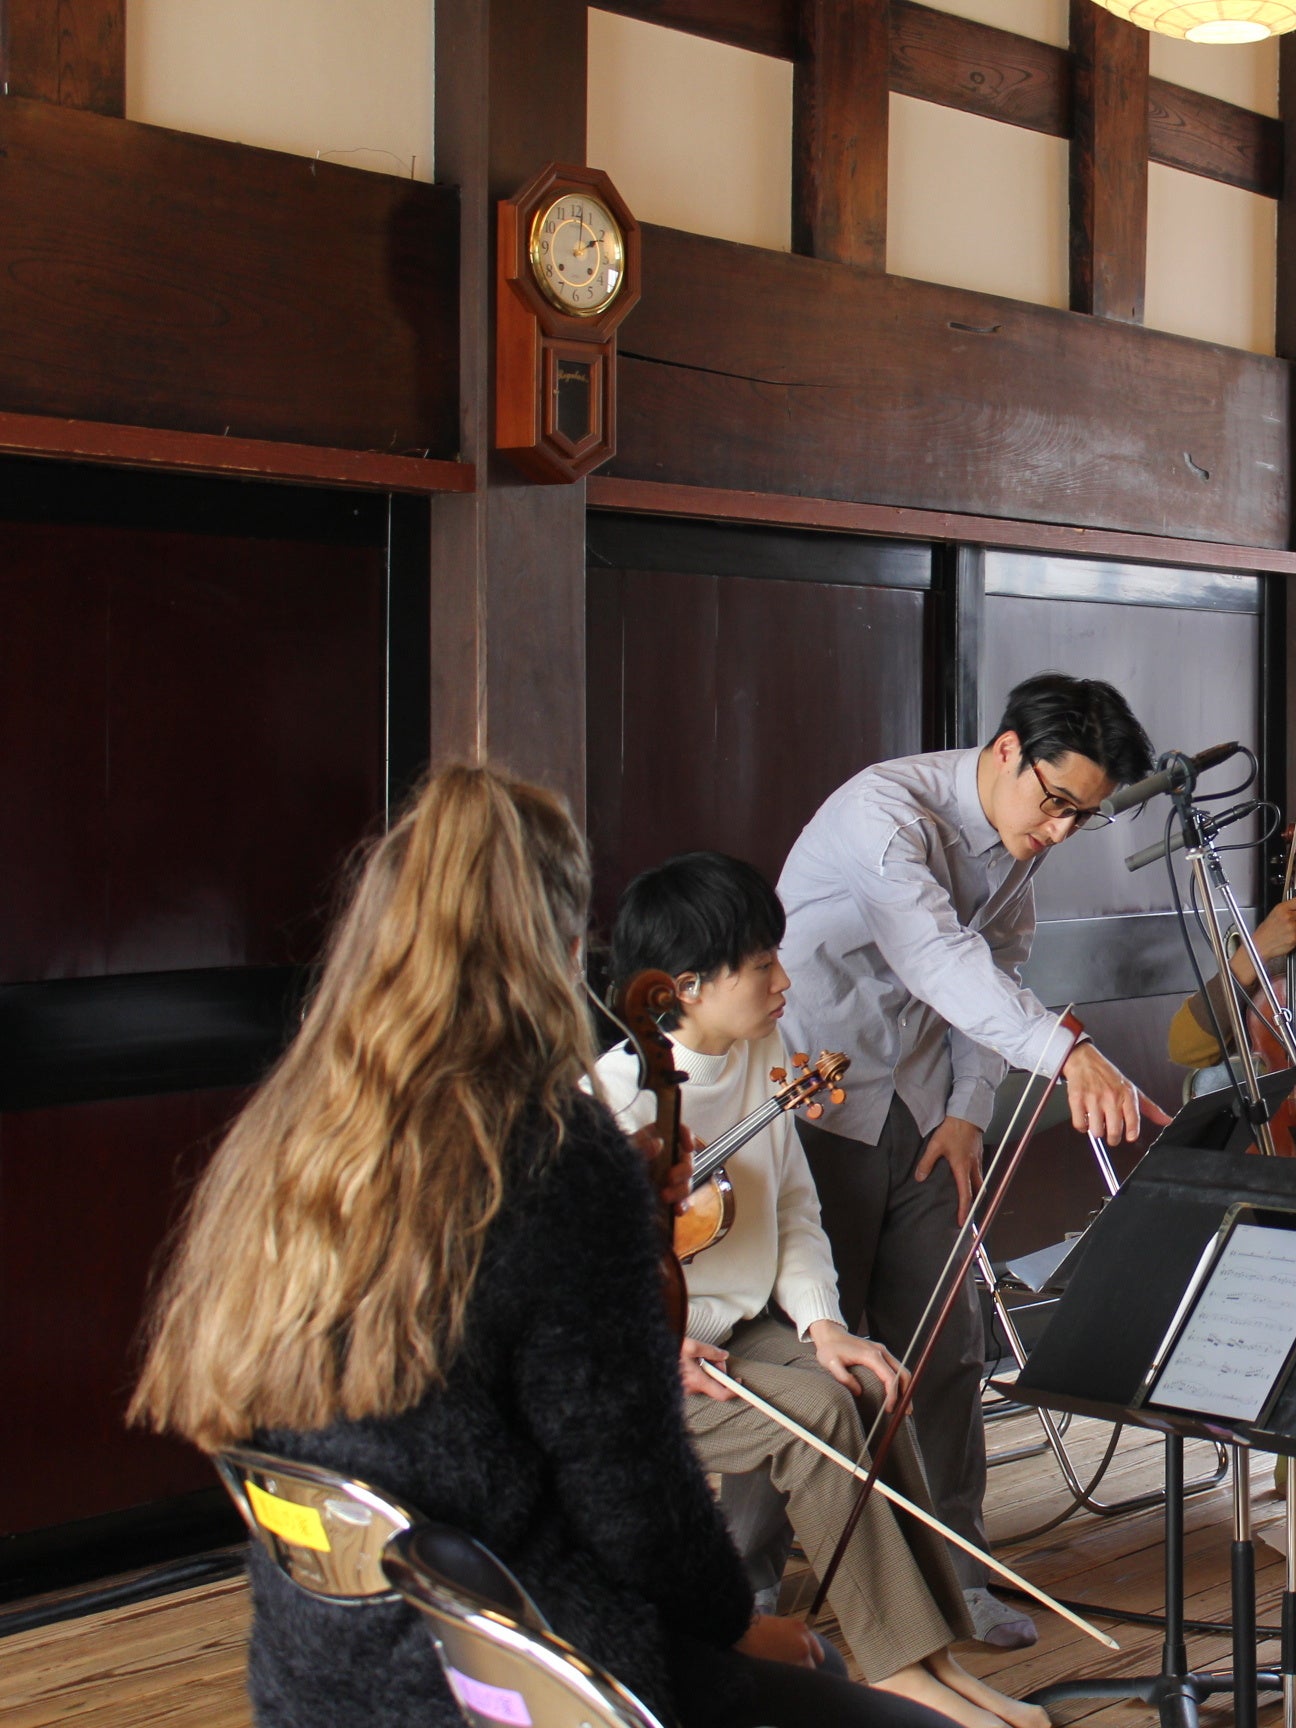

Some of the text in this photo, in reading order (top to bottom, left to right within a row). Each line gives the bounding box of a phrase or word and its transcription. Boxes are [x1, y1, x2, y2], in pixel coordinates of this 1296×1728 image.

[557, 206, 565, 221] 11
[571, 204, 582, 218] 12
[588, 212, 593, 225] 1
[545, 220, 556, 234] 10
[599, 229, 606, 242] 2
[542, 240, 549, 255] 9
[546, 264, 553, 277] 8
[596, 273, 604, 286] 4
[558, 281, 565, 294] 7
[587, 285, 593, 299] 5
[572, 289, 579, 302] 6
